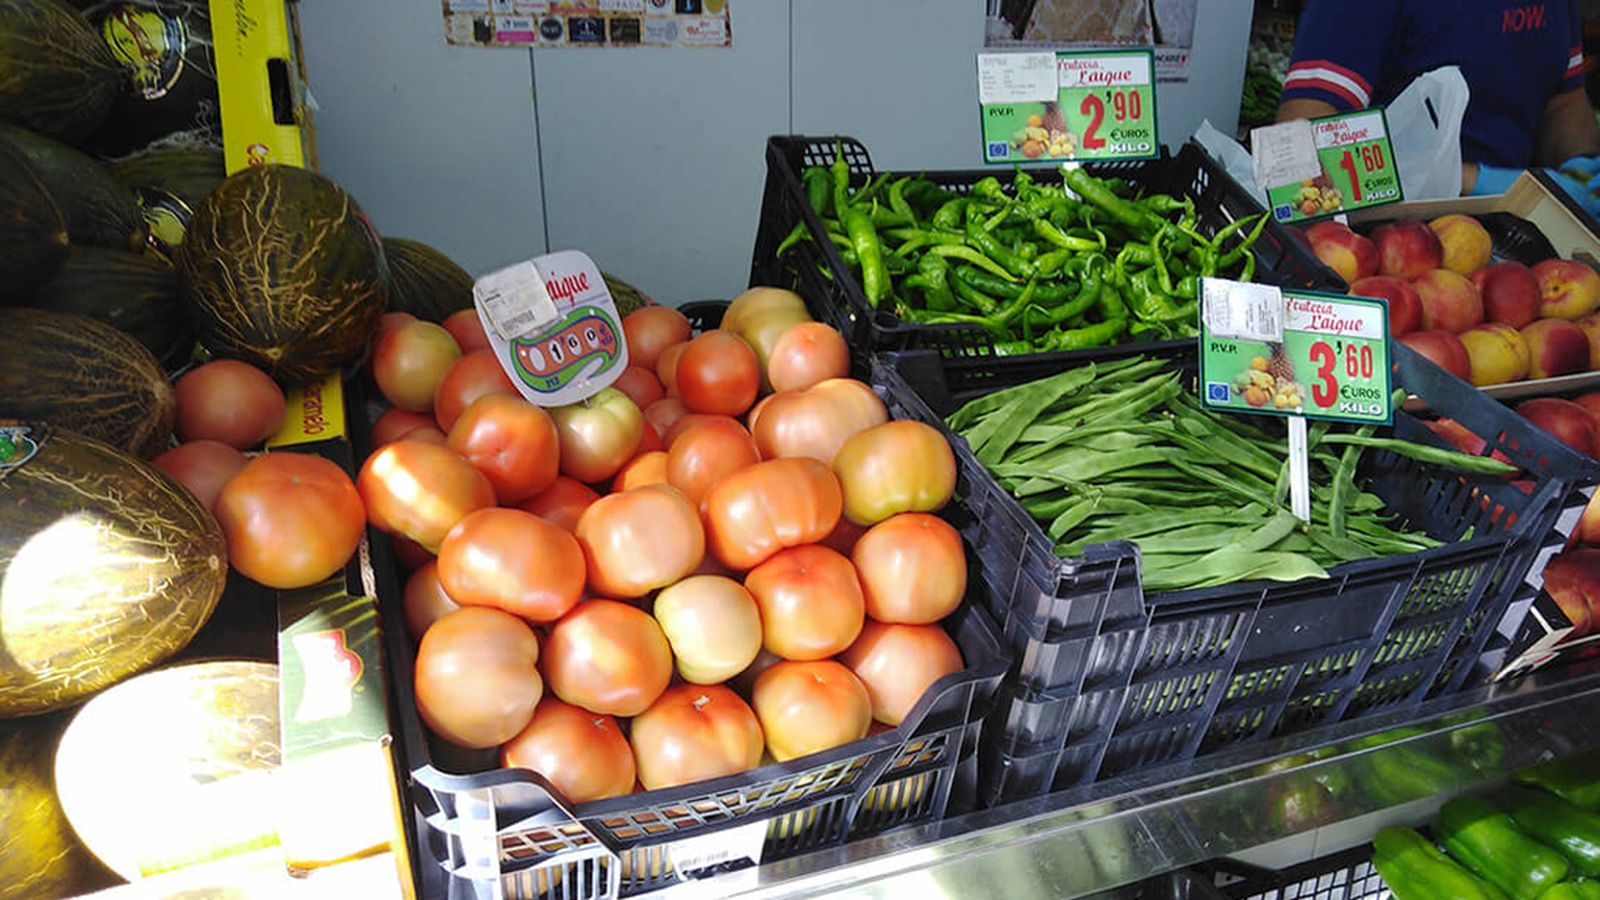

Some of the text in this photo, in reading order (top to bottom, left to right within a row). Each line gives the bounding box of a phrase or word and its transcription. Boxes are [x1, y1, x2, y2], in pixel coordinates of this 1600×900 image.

[1110, 143, 1150, 153] KILO
[1366, 188, 1396, 202] KILO
[546, 271, 590, 306] aigue
[1339, 402, 1382, 415] KILO
